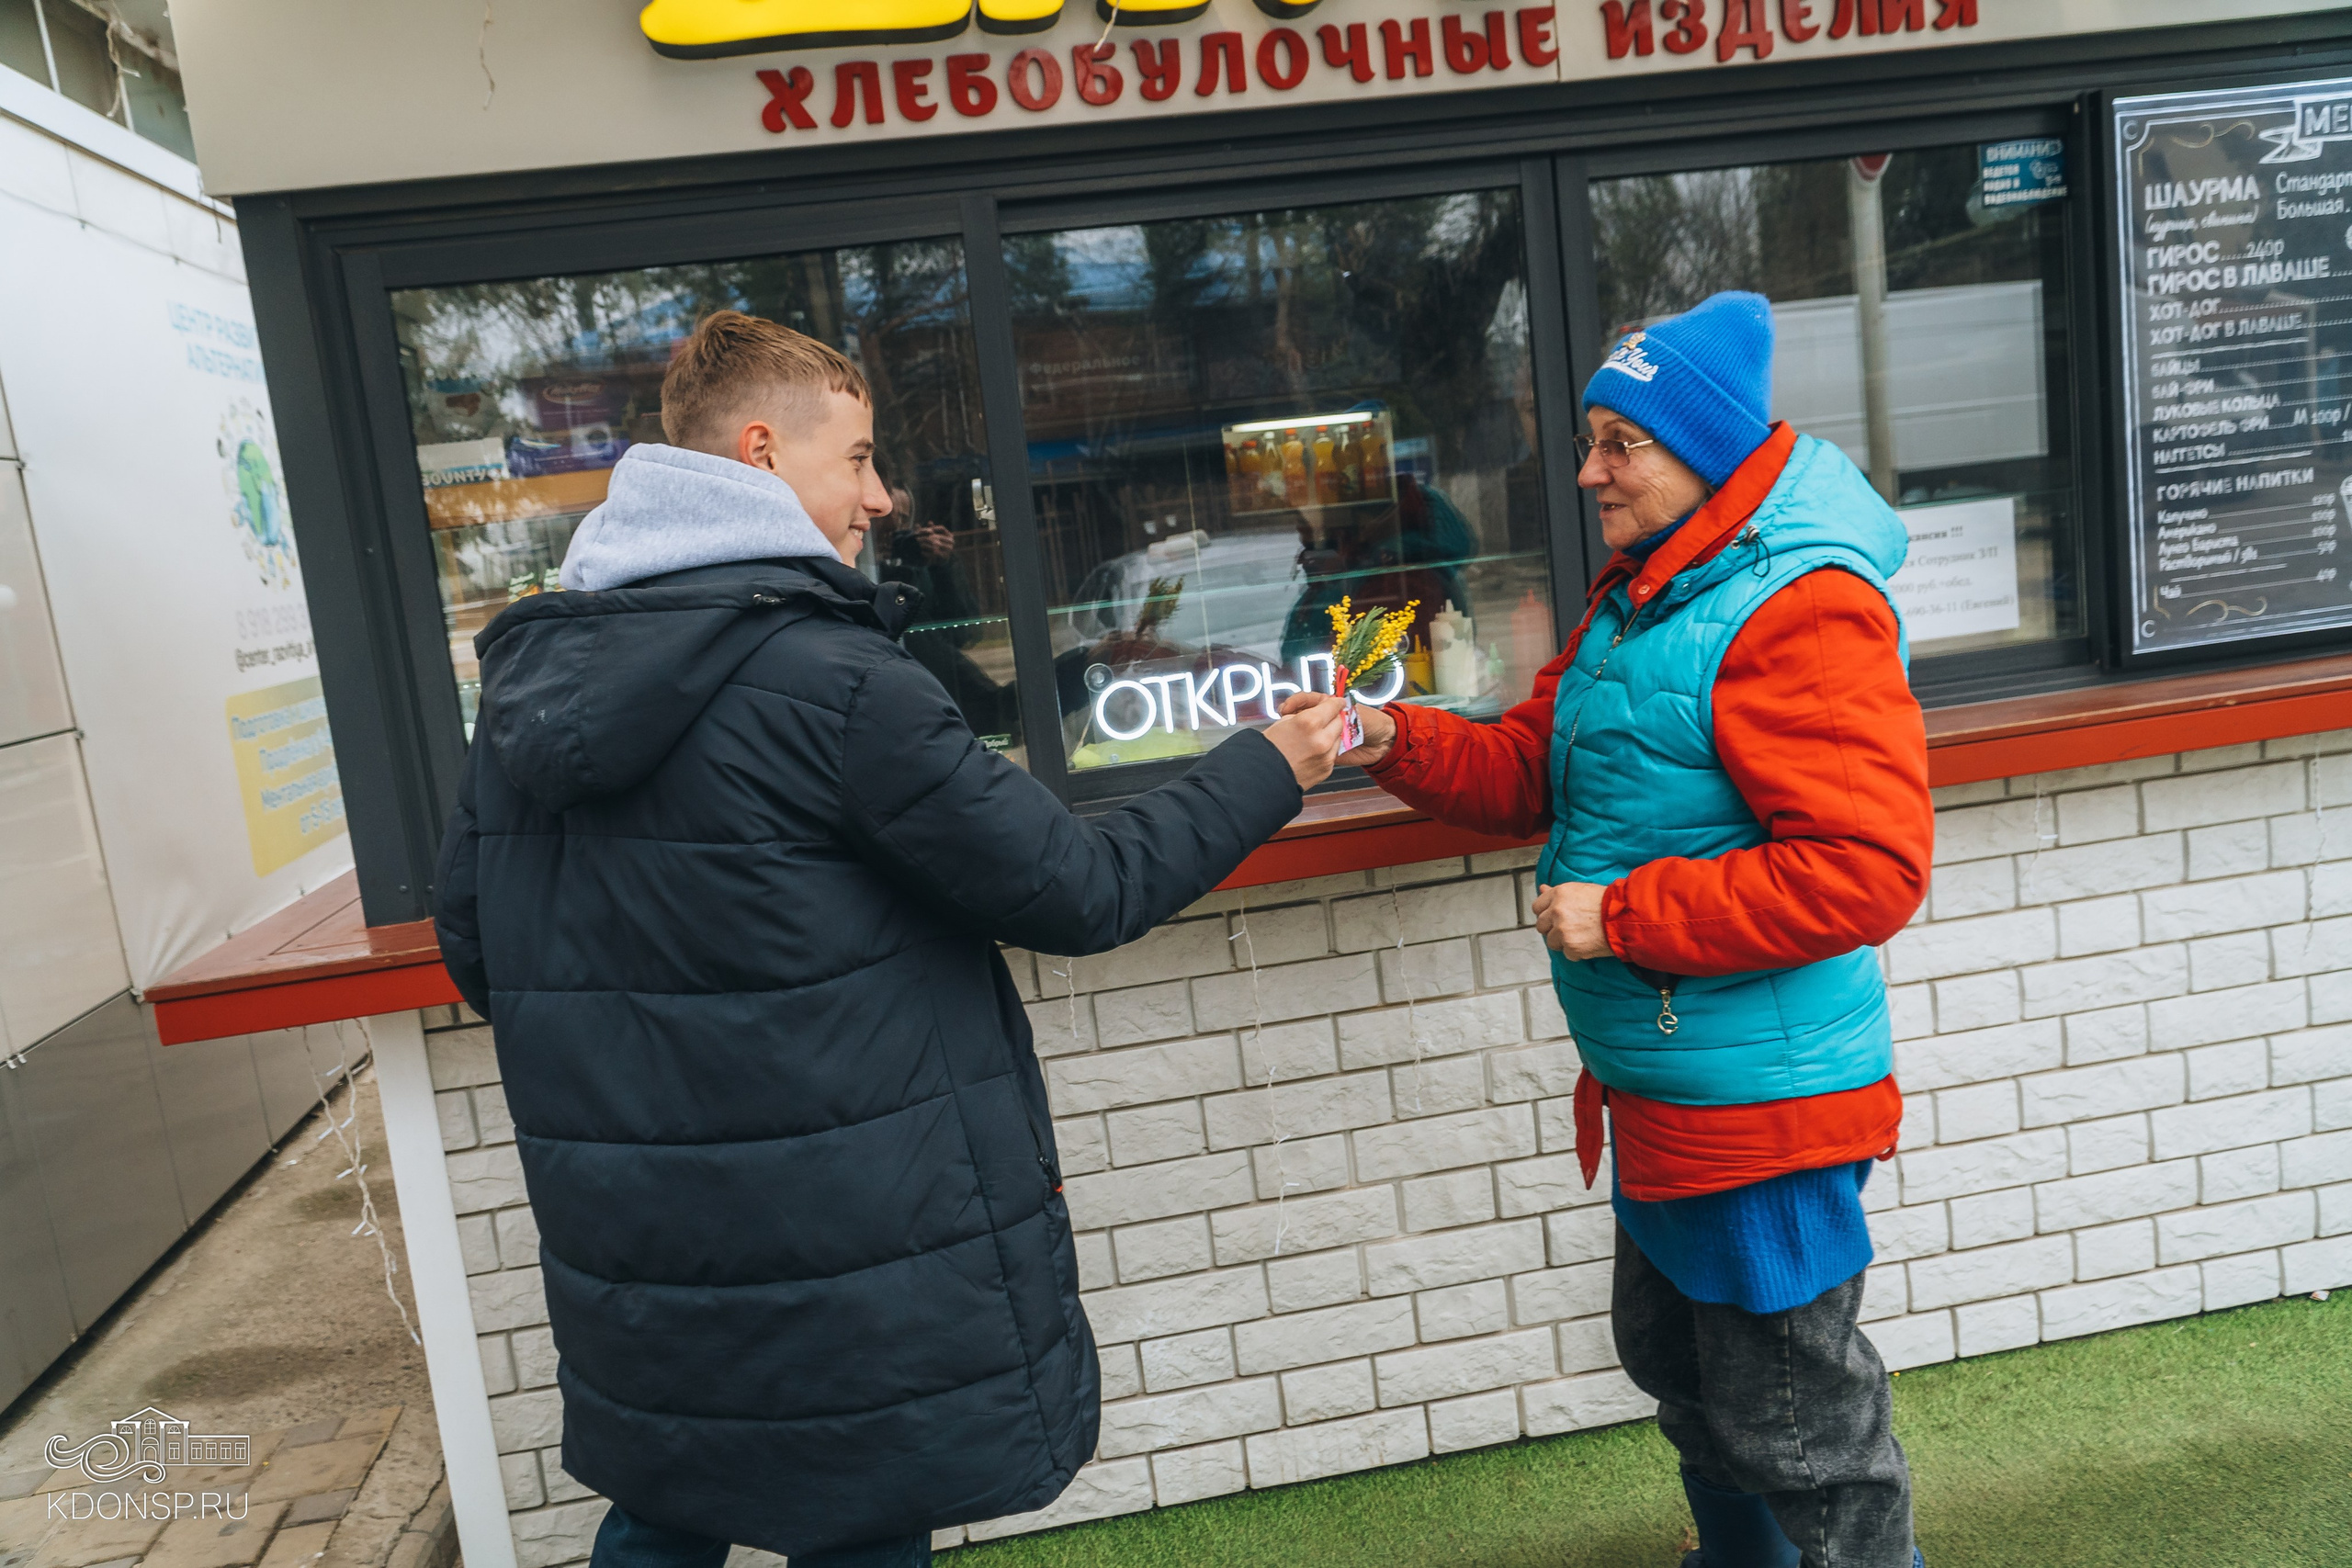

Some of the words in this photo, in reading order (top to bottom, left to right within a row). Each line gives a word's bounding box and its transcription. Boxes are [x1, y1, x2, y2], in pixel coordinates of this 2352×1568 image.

[755, 6, 1559, 133] ХЛЕБОБУЛОЧНЫЕ
[2304, 104, 2352, 136] МЕ
[2144, 174, 2260, 211] ШАУРМА
[2146, 240, 2221, 270] ГИРОС
[2147, 267, 2221, 297] ГИРОС
[2222, 265, 2238, 288] В
[2240, 255, 2331, 287] ЛАВАШЕ
[2149, 298, 2222, 322] ХОТ-ДОГ
[2150, 321, 2223, 346] ХОТ-ДОГ
[2223, 319, 2236, 338] В
[2237, 312, 2303, 336] ЛАВАШЕ
[2221, 391, 2281, 413] КОЛЬЦА
[2153, 419, 2238, 445] КАРТОФЕЛЬ
[2153, 441, 2226, 466] НАГГЕТСЫ
[2155, 476, 2233, 502] ГОРЯЧИЕ
[2235, 466, 2315, 492] НАПИТКИ
